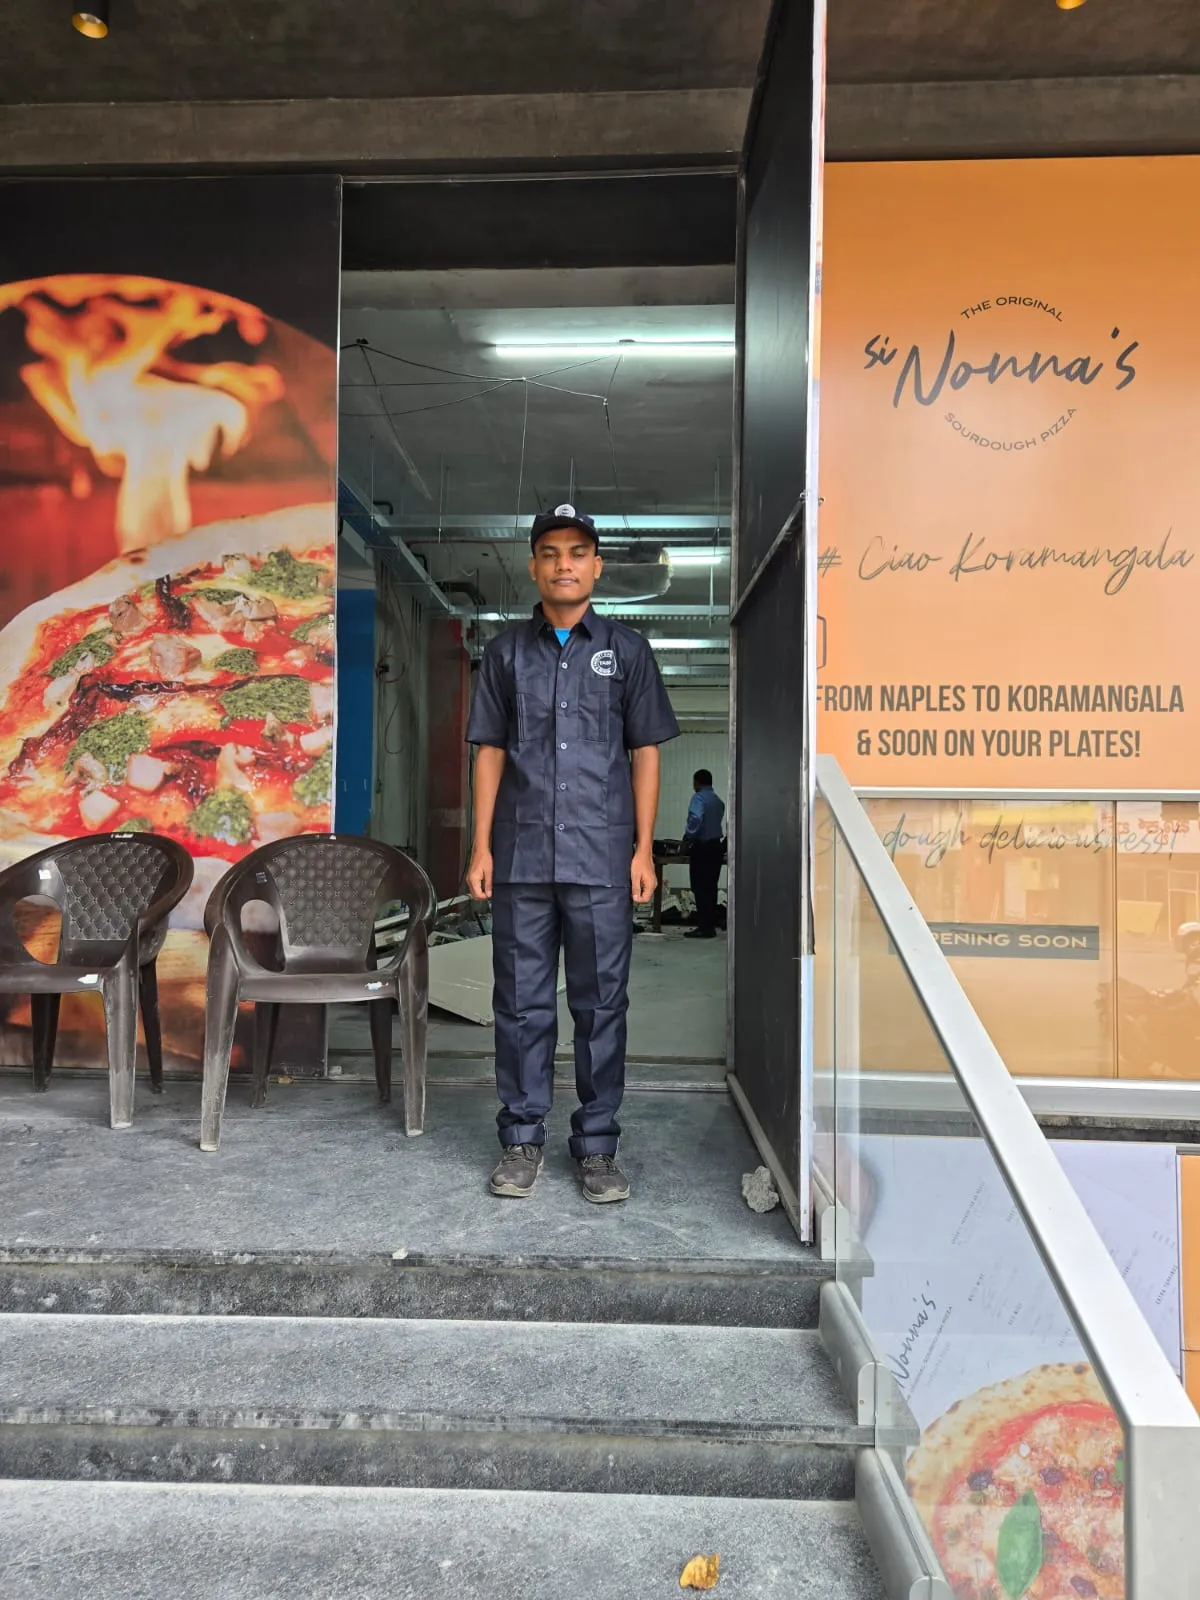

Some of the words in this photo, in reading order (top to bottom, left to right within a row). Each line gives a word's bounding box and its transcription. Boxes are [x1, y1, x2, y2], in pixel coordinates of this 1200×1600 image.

[960, 299, 992, 322] THE
[995, 296, 1064, 322] ORIGINAL
[892, 326, 1140, 408] Nonna's
[944, 411, 1037, 452] SOURDOUGH
[1040, 407, 1078, 443] PIZZA
[858, 535, 942, 581] Ciao
[948, 526, 1197, 596] Koramangala
[880, 684, 966, 712] NAPLES
[972, 684, 1001, 712] TO
[1007, 684, 1185, 713] KORAMANGALA
[857, 729, 872, 756] &
[877, 729, 938, 756] SOON
[944, 729, 975, 757] ON
[981, 729, 1042, 757] YOUR
[1048, 729, 1141, 758] PLATES!
[932, 931, 1011, 947] PENING
[1017, 933, 1088, 949] SOON
